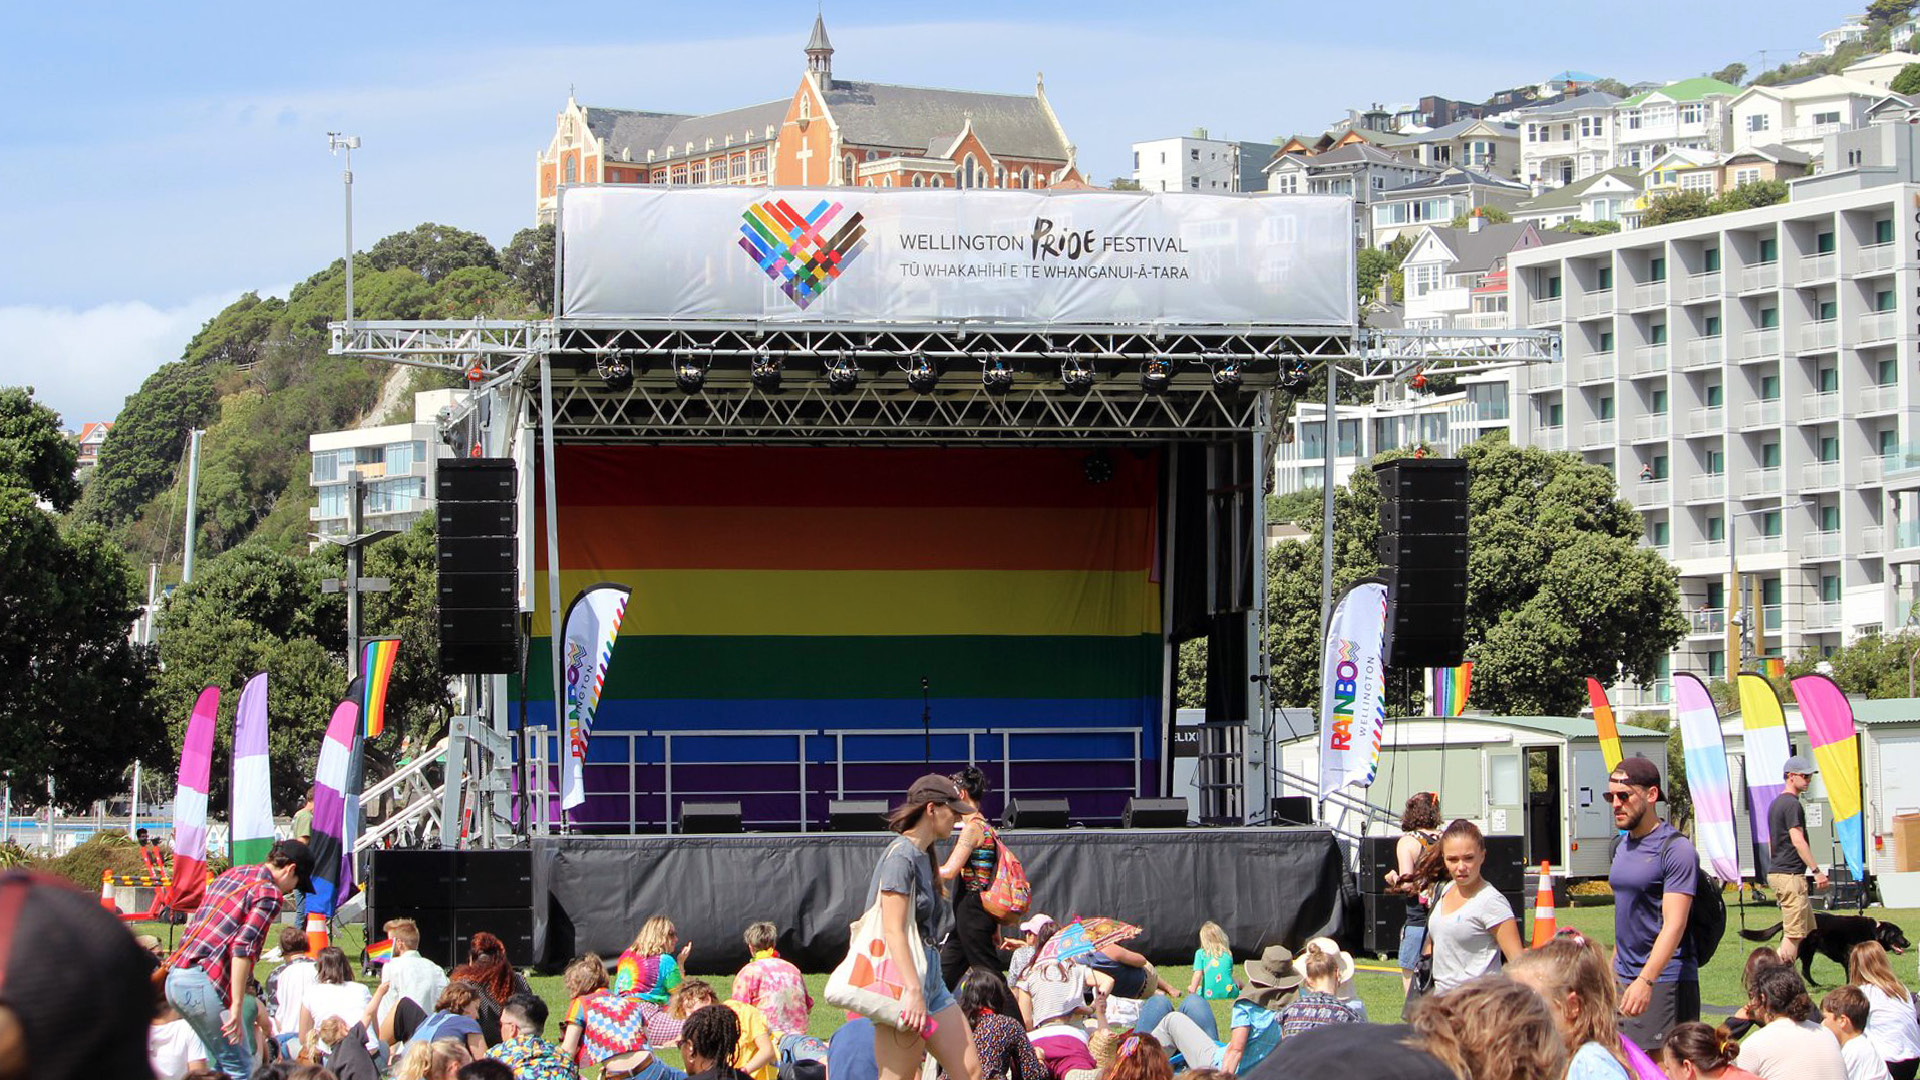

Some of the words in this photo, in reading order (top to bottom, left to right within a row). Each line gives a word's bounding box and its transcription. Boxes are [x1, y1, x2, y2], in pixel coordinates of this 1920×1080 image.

[900, 234, 1024, 251] WELLINGTON
[1103, 236, 1189, 253] FESTIVAL
[900, 261, 920, 277] TŪ
[1011, 266, 1018, 278] E
[1023, 266, 1041, 278] TE
[1330, 638, 1361, 750] RAINBOW
[1359, 656, 1375, 737] WELLINGTON
